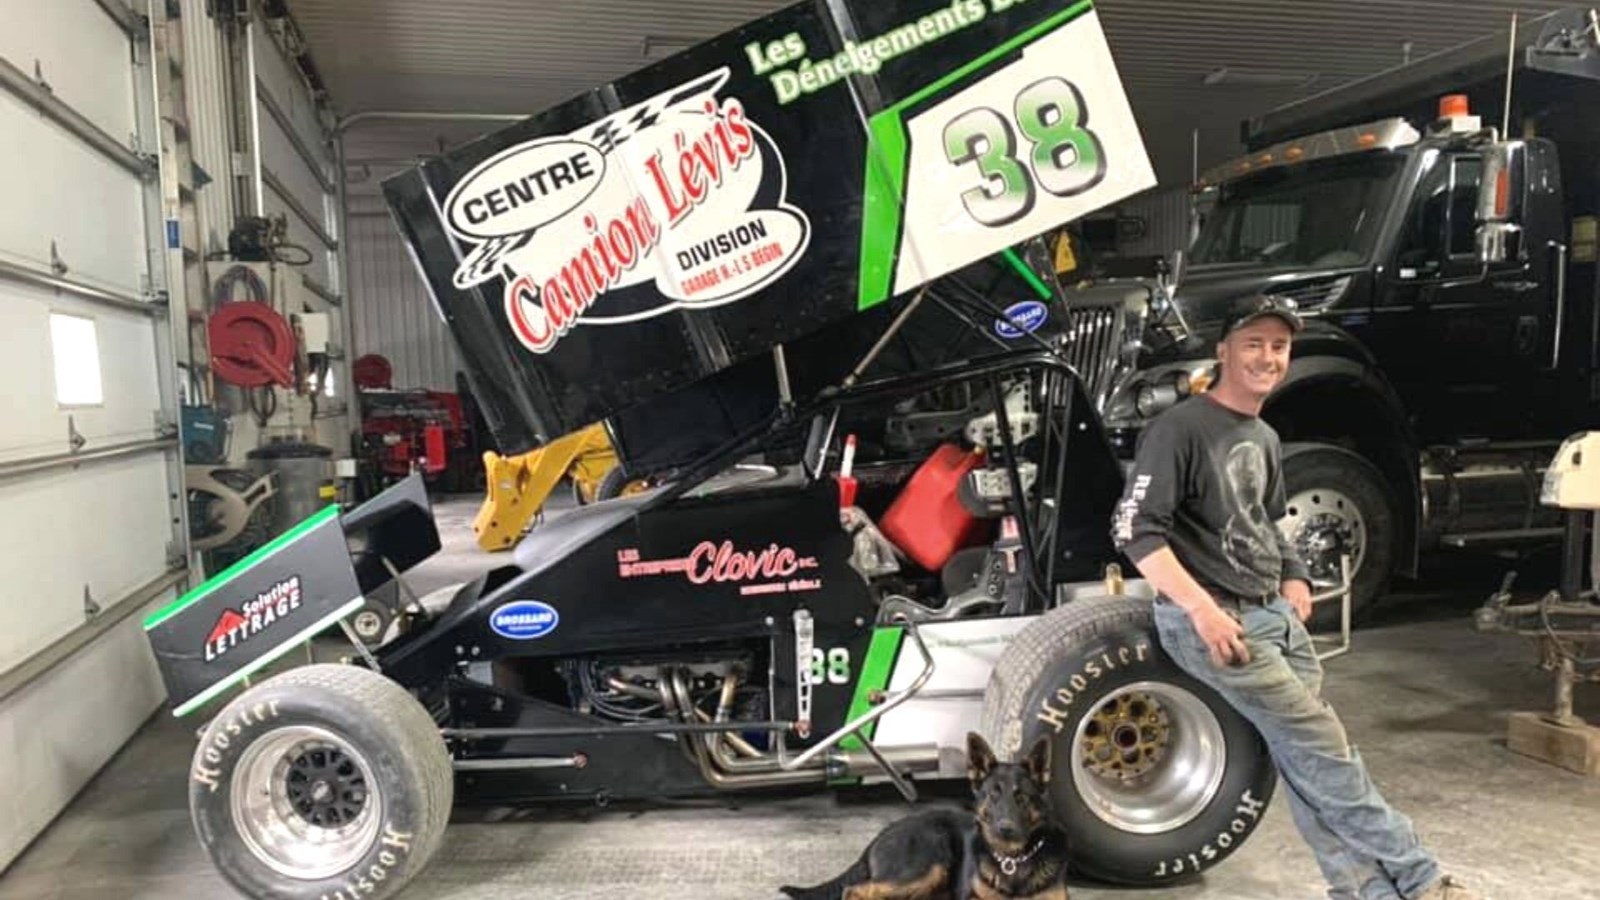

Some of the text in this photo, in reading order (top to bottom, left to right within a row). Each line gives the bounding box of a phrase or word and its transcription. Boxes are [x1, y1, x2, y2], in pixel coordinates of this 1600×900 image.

[745, 32, 806, 76] Les
[769, 0, 987, 105] Déneigements
[463, 152, 595, 225] CENTRE
[942, 76, 1107, 228] 38
[508, 99, 756, 350] Camion Lévis
[676, 218, 768, 271] DIVISION
[242, 576, 299, 618] Solution
[688, 539, 799, 584] Clovic
[206, 588, 300, 661] LETTRAGE
[1037, 642, 1148, 733] Hoosier
[194, 698, 281, 792] Hoosier
[1154, 788, 1264, 878] Hoosier
